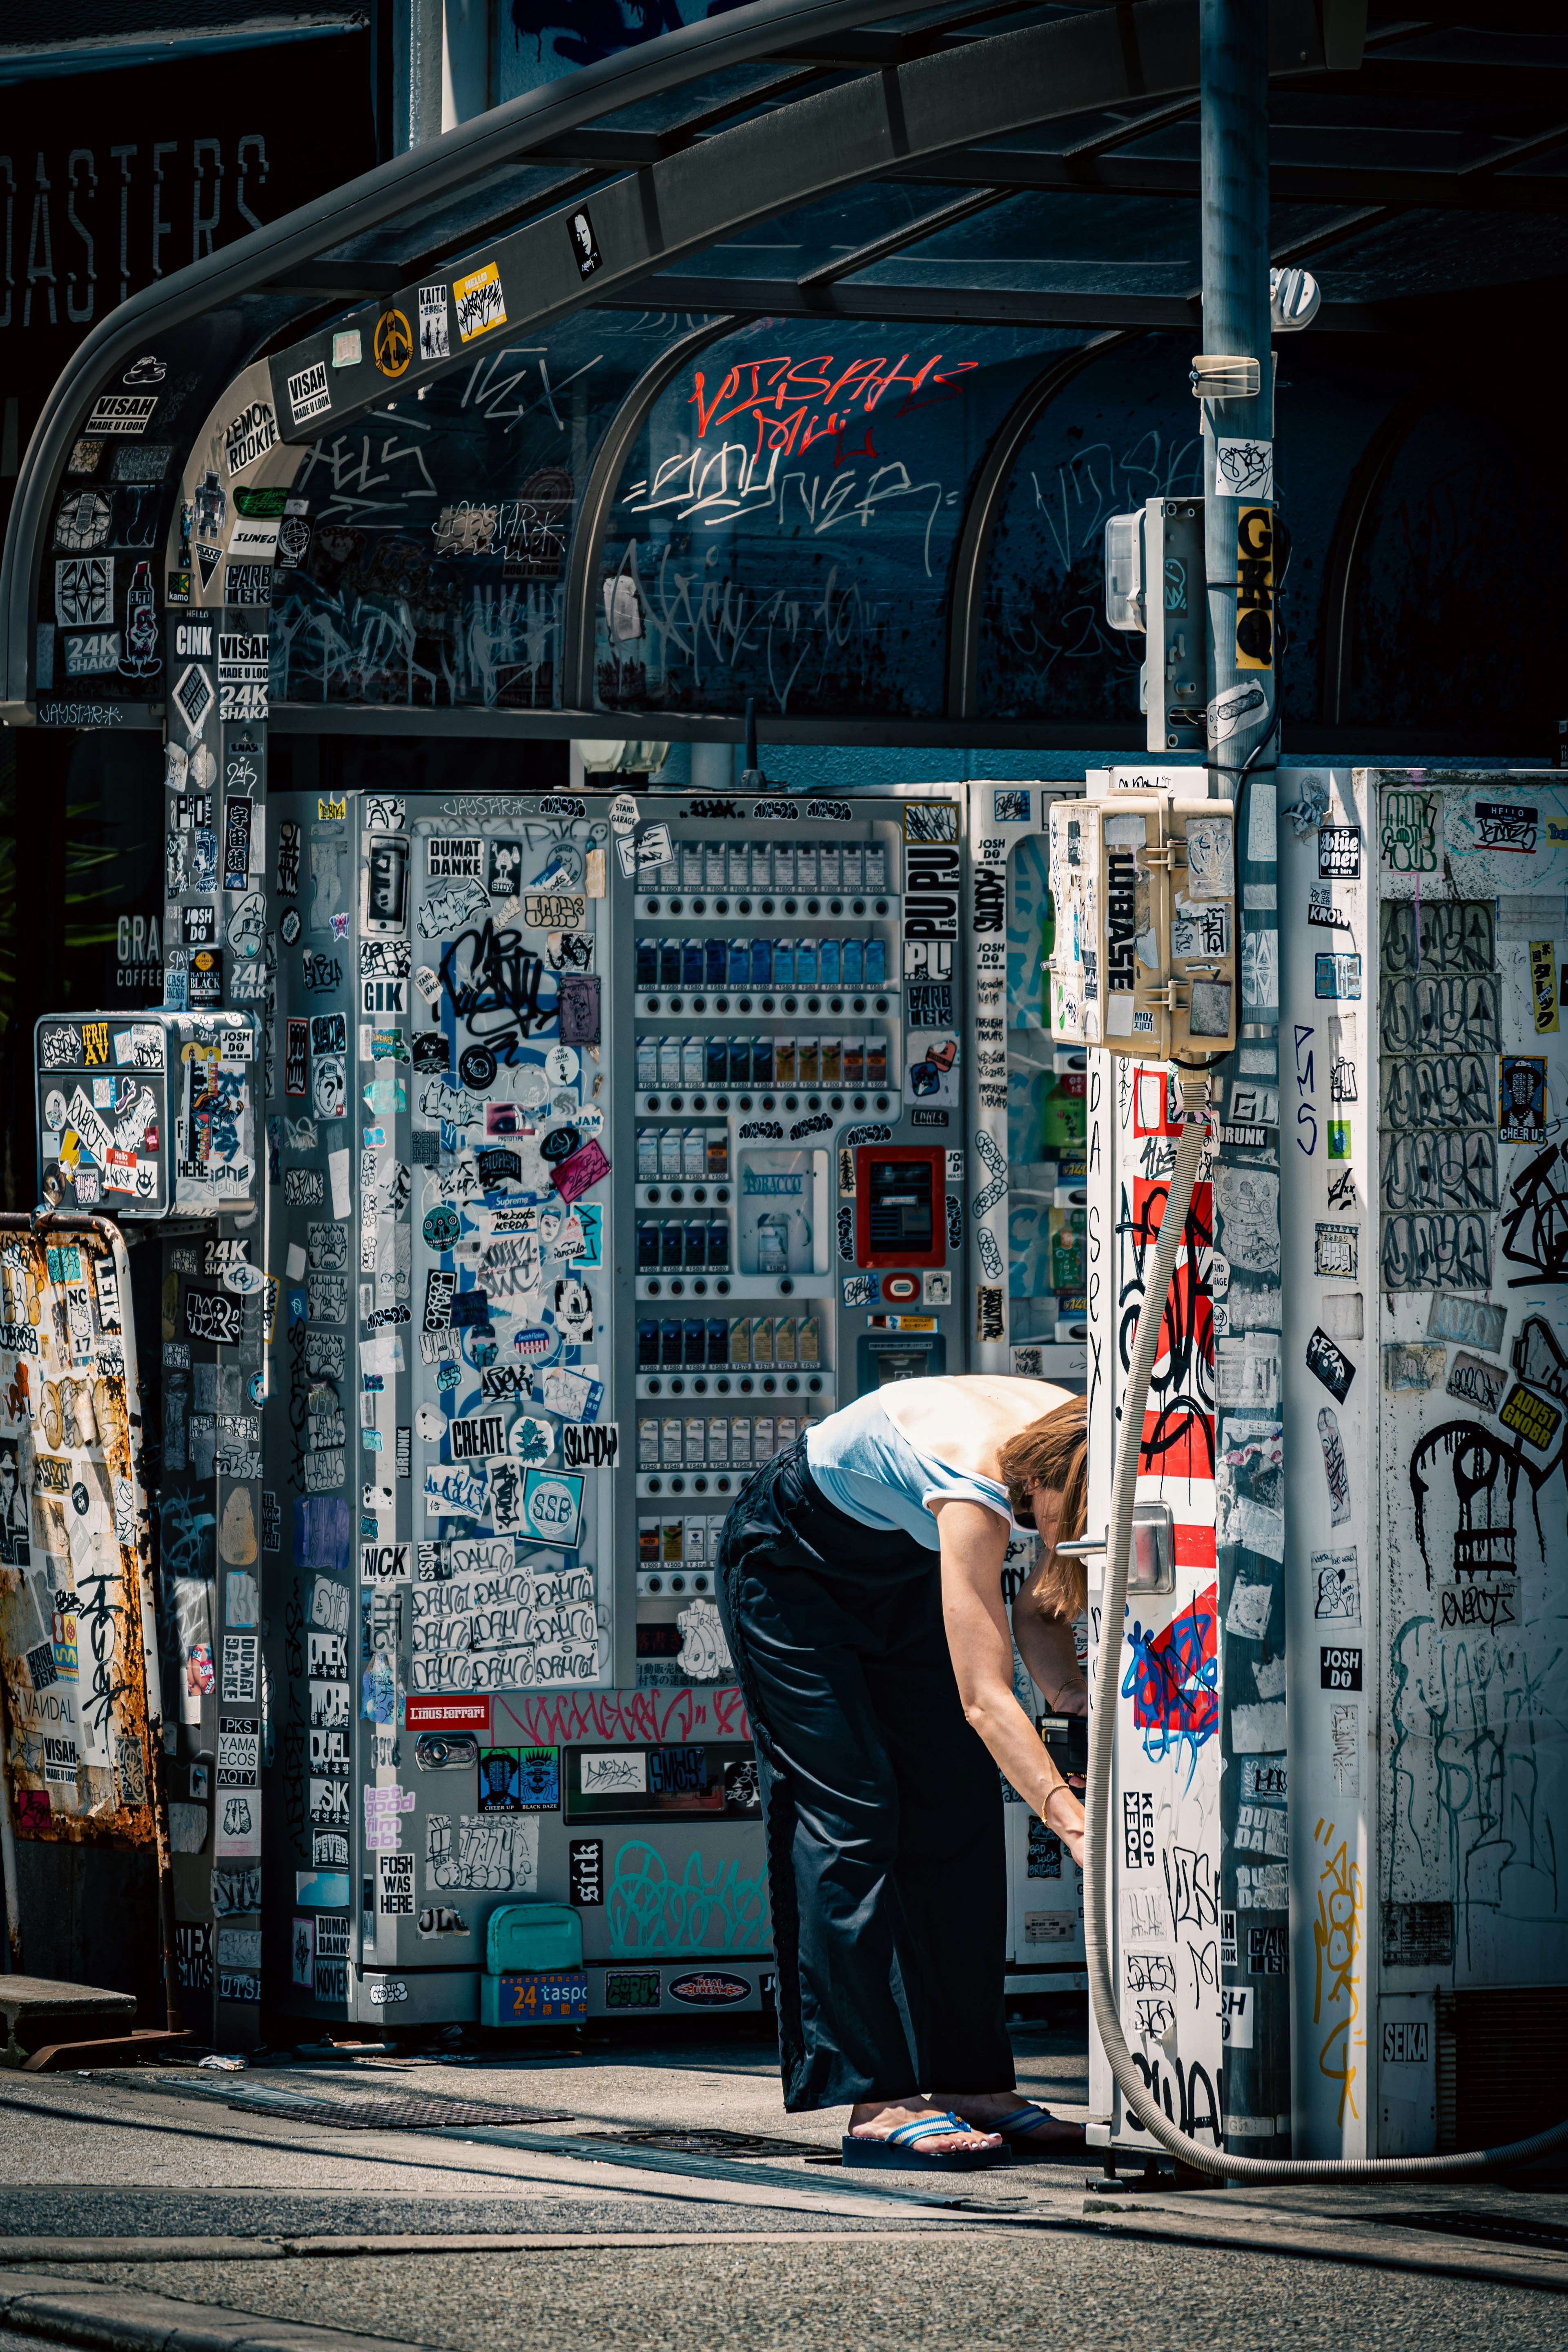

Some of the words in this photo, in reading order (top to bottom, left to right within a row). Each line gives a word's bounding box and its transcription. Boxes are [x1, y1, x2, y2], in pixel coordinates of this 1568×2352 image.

[465, 272, 487, 290] HELLO
[420, 286, 446, 305] KAITO
[424, 304, 442, 316] 世界的に
[290, 365, 325, 402] VISAH
[96, 399, 155, 415] VISAH
[294, 401, 310, 424] MADE
[310, 401, 316, 415] U
[315, 394, 330, 414] LOOK
[87, 422, 112, 430] MADE
[114, 422, 120, 430] U
[123, 422, 146, 430] LOOK
[229, 419, 277, 473] ROOKIE
[196, 548, 220, 560] SLANG
[227, 565, 272, 589] CARB
[169, 593, 189, 601] kamo
[68, 634, 118, 659] 24K
[176, 626, 212, 655] CINK
[69, 657, 119, 673] SHAKA
[219, 668, 242, 678] MADE
[245, 668, 250, 677] U
[220, 685, 268, 706] 24K
[615, 803, 634, 813] STAND
[611, 815, 636, 825] GARAGE
[229, 806, 247, 870] 宇宙猿
[978, 839, 1005, 849] JOSH
[430, 840, 481, 858] DUMAT
[430, 859, 481, 875] DANKE
[1321, 851, 1358, 867] oner
[492, 882, 513, 893] SIDY
[185, 909, 212, 925] JOSH
[977, 943, 1005, 953] JOSH
[117, 969, 163, 987] COFFEE
[190, 978, 220, 988] BLACK
[364, 982, 403, 1012] GIK
[910, 985, 951, 1006] CARB
[1537, 987, 1552, 1002] Tarek
[1134, 1012, 1153, 1022] MOZ
[82, 1022, 108, 1044] IFRIT
[1134, 1022, 1153, 1031] 재미
[223, 1032, 250, 1042] JOSH
[85, 1044, 108, 1066] AV
[575, 1116, 601, 1126] JAM
[1500, 1127, 1529, 1141] CHEER
[1531, 1128, 1544, 1142] UP
[115, 1152, 128, 1160] Hello
[481, 1153, 520, 1175] SWASH
[178, 1159, 209, 1177] HERE
[746, 1178, 802, 1192] TOBACCO
[496, 1196, 528, 1206] Supreme
[494, 1221, 529, 1231] MERDA
[205, 1241, 248, 1261] 24K
[68, 1289, 87, 1305] NC
[75, 1337, 90, 1353] 17
[1512, 1389, 1557, 1430] ADV51
[1502, 1405, 1552, 1449] GNOBR
[452, 1417, 504, 1458] CREATE
[364, 1547, 405, 1577] NICK
[1323, 1650, 1359, 1669] JOSH
[240, 1638, 255, 1701] DUMAT
[226, 1720, 252, 1733] PKS
[45, 1739, 76, 1765] VISAH
[220, 1737, 256, 1751] YAMA
[219, 1753, 255, 1766] ECOS
[46, 1768, 60, 1781] MADE
[61, 1770, 65, 1781] U
[218, 1770, 255, 1785] AQTY
[364, 1786, 401, 1802] last
[365, 1793, 414, 1817] good
[366, 1817, 400, 1832] film
[1126, 1791, 1140, 1867] POEK
[1142, 1792, 1155, 1867] KEOP
[314, 1833, 349, 1863] FEVER
[1029, 1844, 1046, 1855] BAD
[1029, 1864, 1060, 1876] BRIGADE
[384, 1876, 410, 1893] WAS
[380, 1895, 413, 1914] HERE
[318, 1917, 349, 1936] DUMAT
[692, 1986, 727, 1995] DREAM
[697, 1978, 722, 1987] REAL
[513, 1986, 537, 2009] 24
[1384, 2024, 1428, 2061] SEIKA
